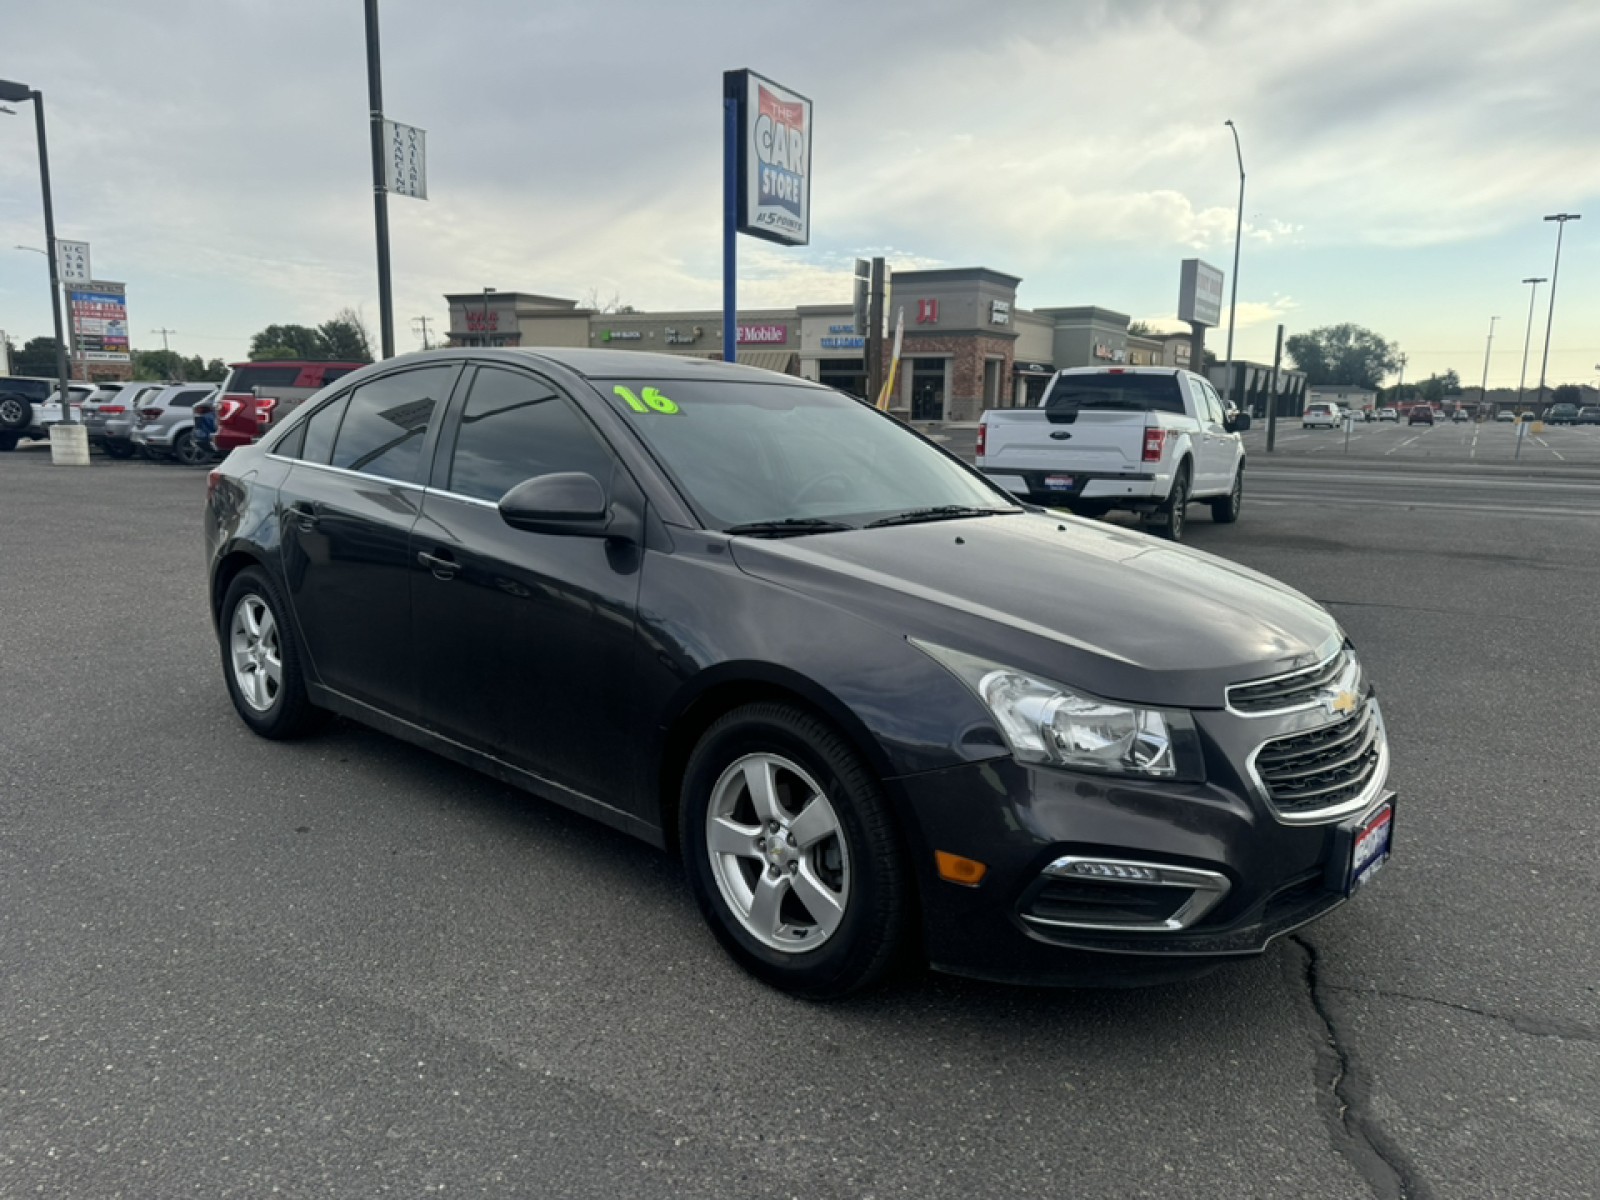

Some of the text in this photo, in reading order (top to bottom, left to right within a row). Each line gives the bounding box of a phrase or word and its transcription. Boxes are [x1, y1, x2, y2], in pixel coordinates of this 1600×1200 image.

[771, 102, 793, 121] THE
[754, 113, 804, 178] CAR
[762, 167, 800, 204] STORE
[765, 212, 777, 225] 5
[776, 216, 802, 230] POINTS
[63, 245, 75, 277] USED
[75, 246, 84, 278] CARS
[744, 325, 783, 341] Mobile
[613, 384, 679, 415] 16
